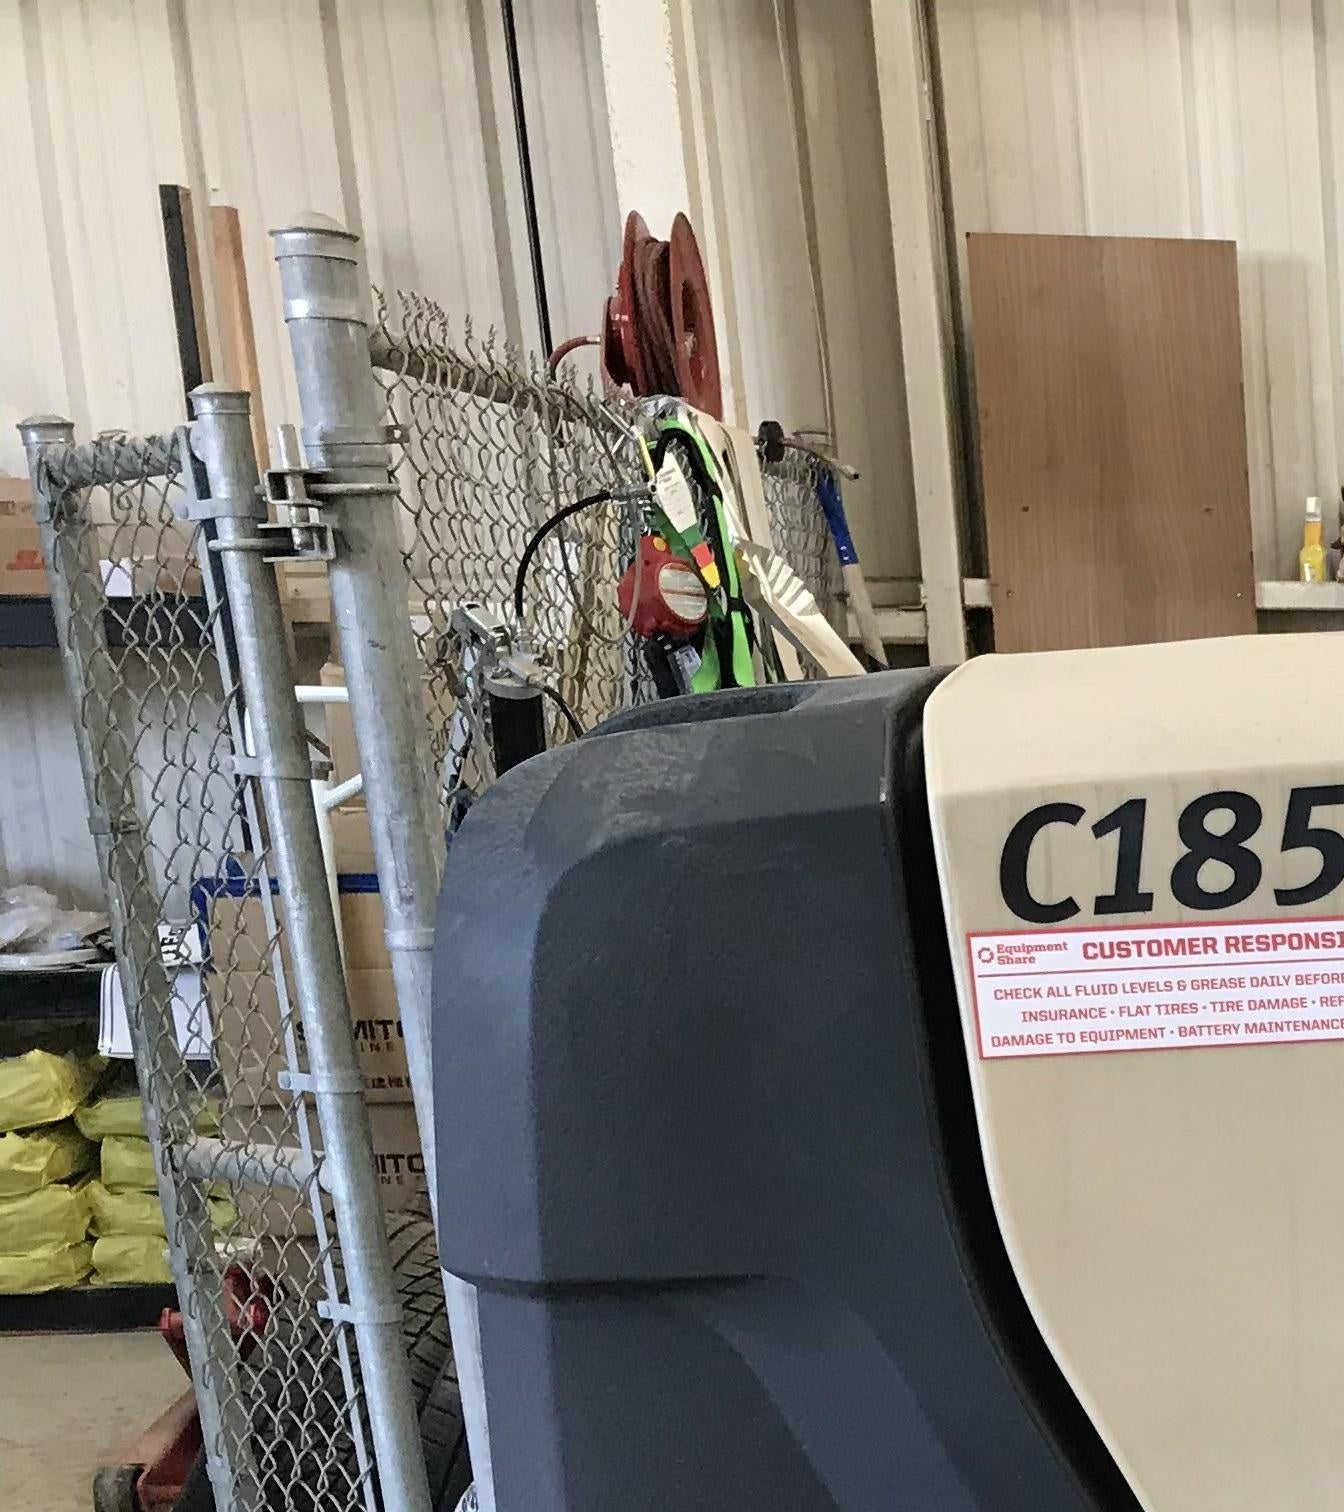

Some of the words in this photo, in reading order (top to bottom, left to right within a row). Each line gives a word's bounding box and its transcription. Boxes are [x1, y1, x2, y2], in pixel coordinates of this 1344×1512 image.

[997, 942, 1068, 955] Equipment
[997, 956, 1035, 965] Share
[1082, 937, 1218, 960] CUSTOMER
[994, 988, 1043, 1000] CHECK
[1047, 986, 1074, 997] ALL
[1075, 983, 1118, 996] FLUID
[1122, 981, 1173, 994] LEVELS
[1177, 980, 1186, 991] &
[1191, 977, 1246, 990] GREASE
[1250, 975, 1291, 987] DAILY
[1021, 1007, 1107, 1022] INSURANCE
[1119, 1005, 1152, 1017] FLAT
[1155, 1003, 1198, 1015] TIRES
[1210, 1000, 1243, 1012] TIRE
[1248, 997, 1307, 1011] DAMAGE
[992, 1033, 1053, 1048] DAMAGE
[1057, 1033, 1075, 1043] TO
[1080, 1028, 1166, 1044] EQUIPMENT
[1178, 1023, 1240, 1037] BATTERY
